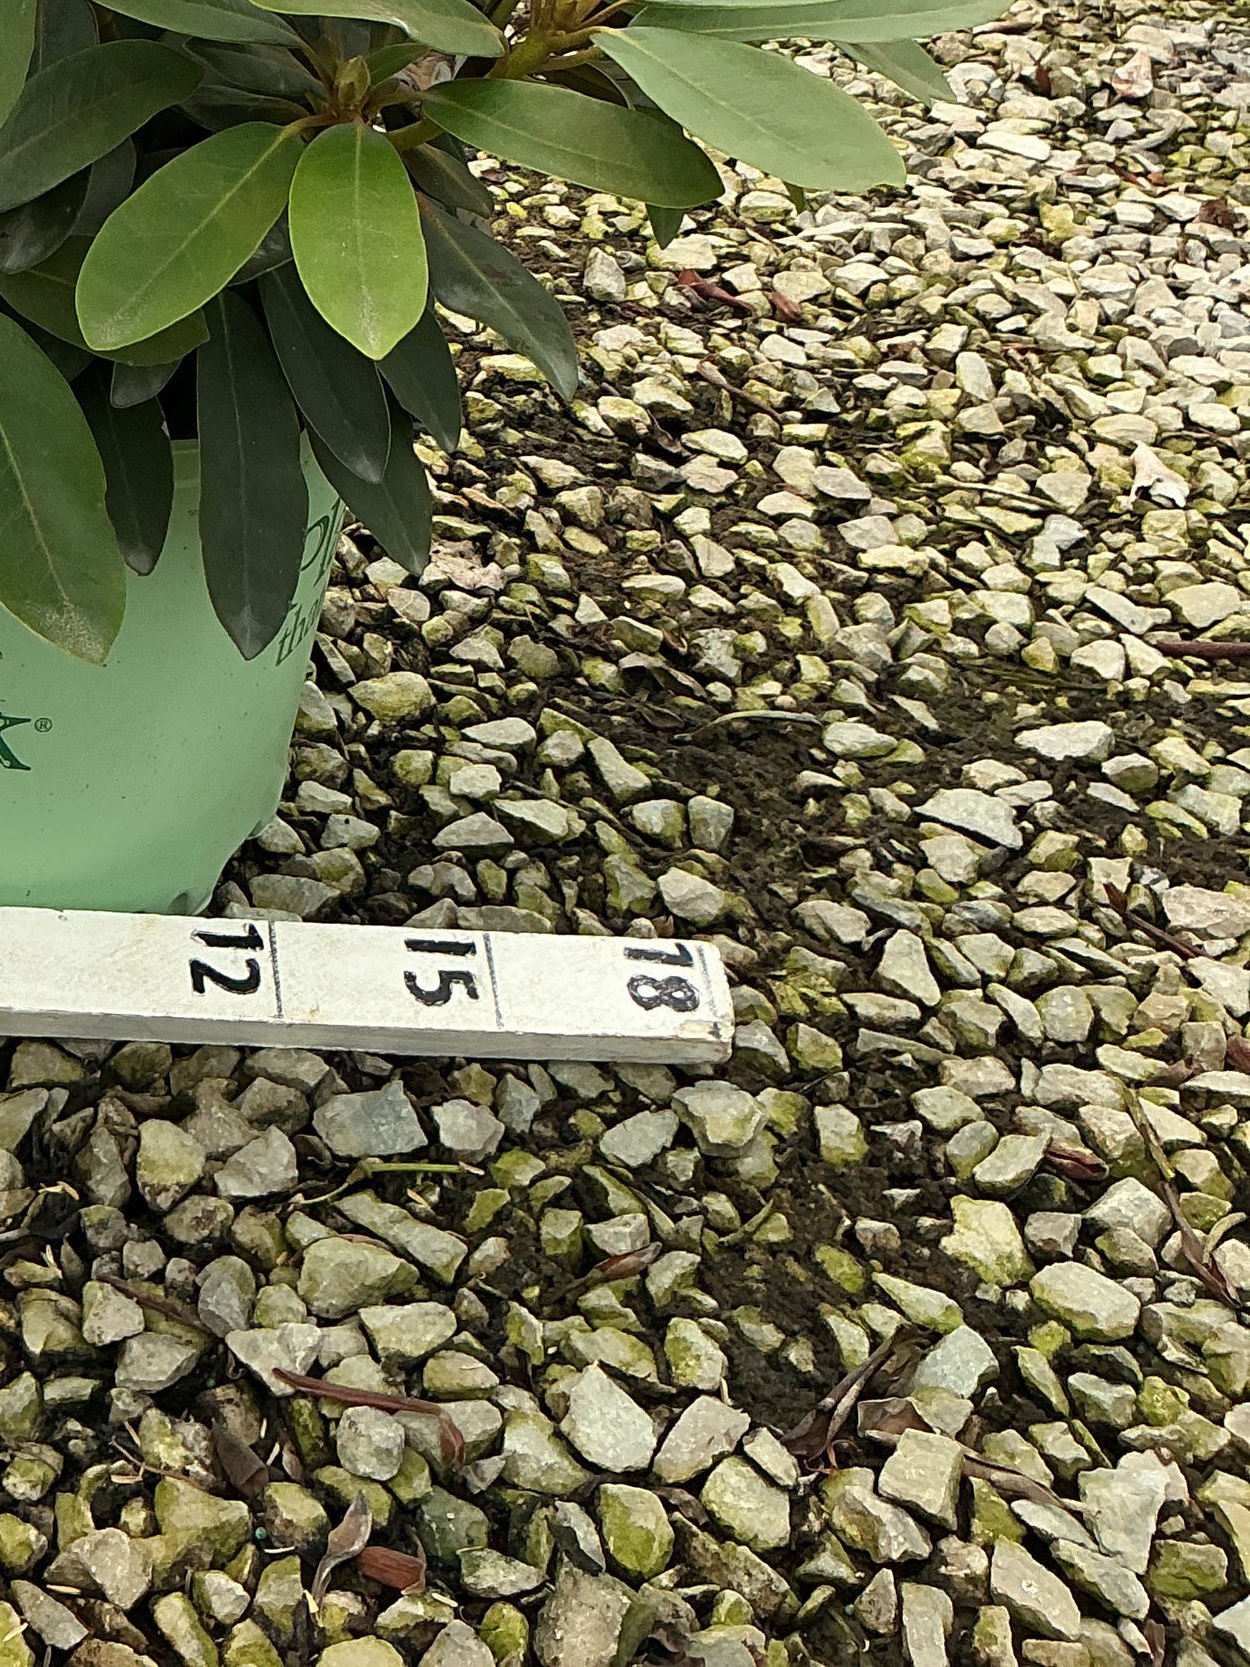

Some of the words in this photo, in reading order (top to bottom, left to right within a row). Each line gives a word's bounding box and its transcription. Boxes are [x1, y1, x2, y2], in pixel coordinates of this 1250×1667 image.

[189, 923, 265, 996] 12
[402, 937, 481, 1007] 15
[622, 941, 701, 1014] 18
